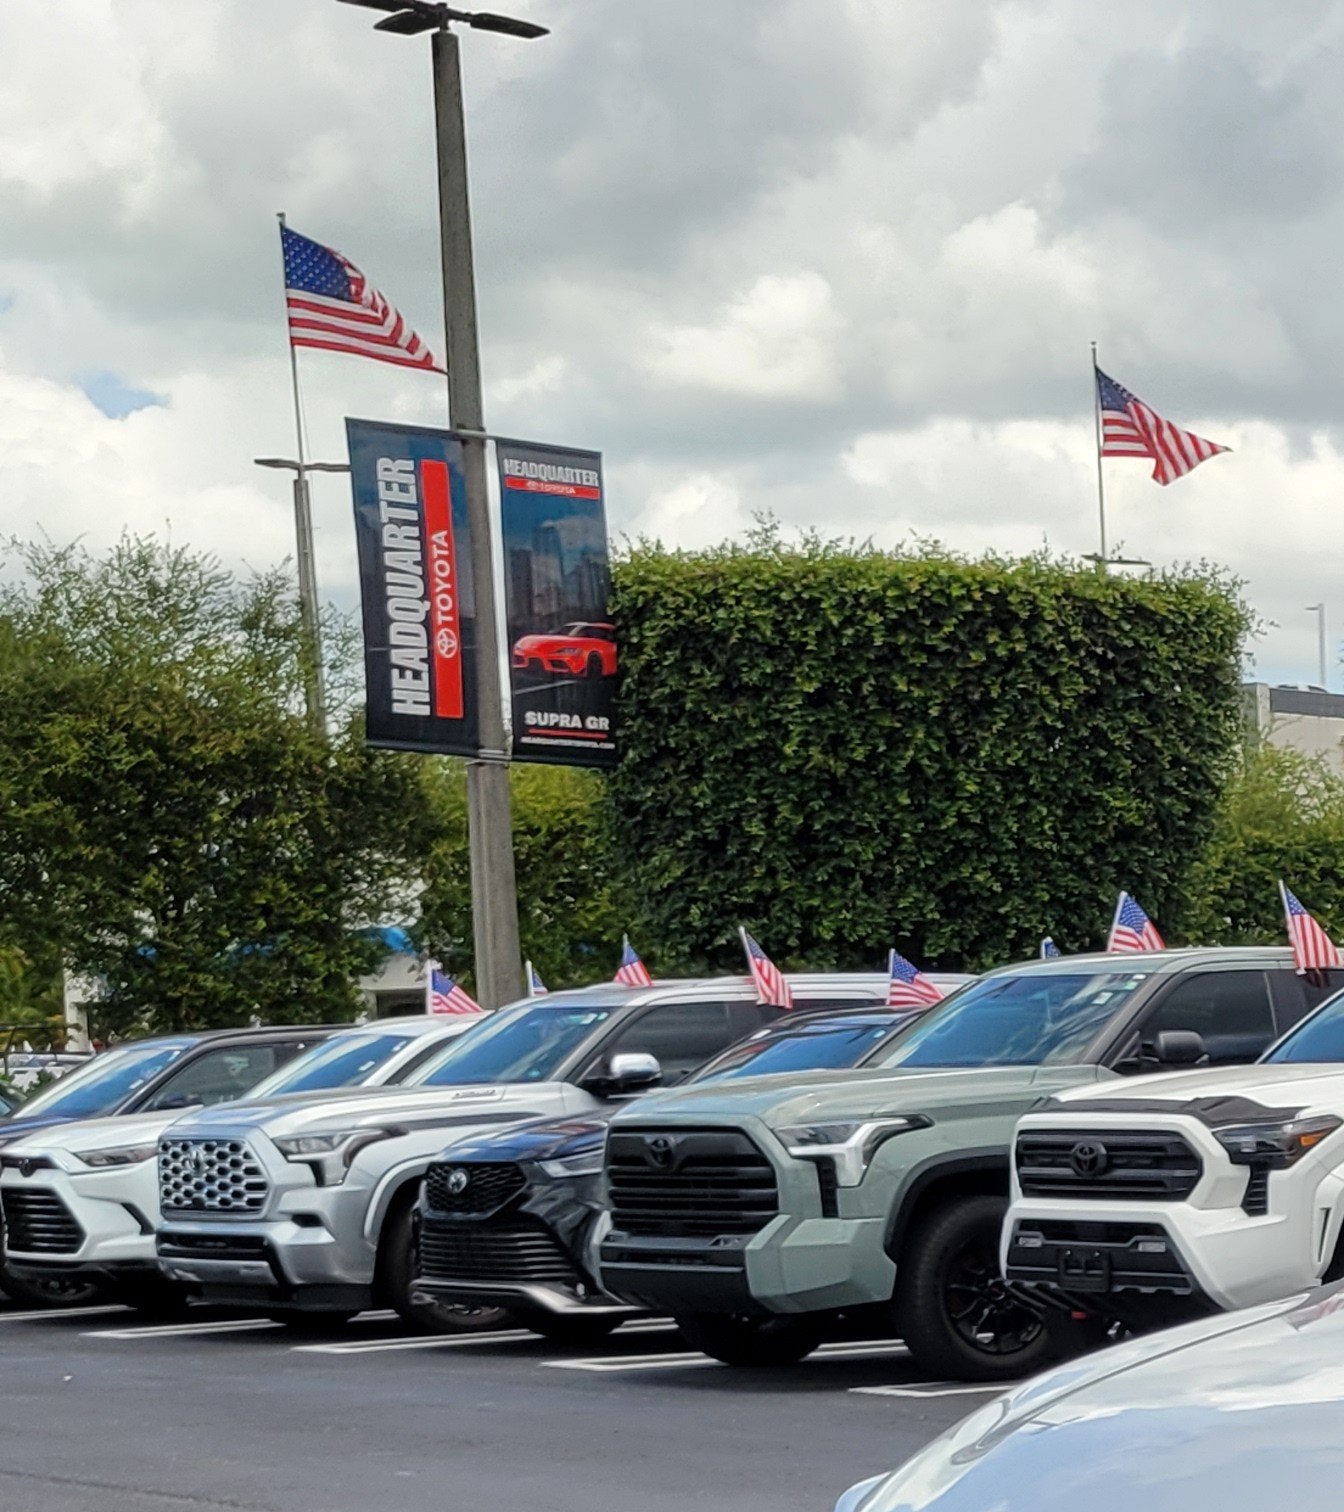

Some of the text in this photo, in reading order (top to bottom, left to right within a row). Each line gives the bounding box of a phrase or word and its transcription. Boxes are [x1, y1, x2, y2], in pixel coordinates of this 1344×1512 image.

[503, 458, 600, 487] HEADQUARTER
[376, 457, 431, 716] HEADQUARTER
[431, 530, 454, 625] TOYOTA
[525, 711, 610, 731] SUPRA GR
